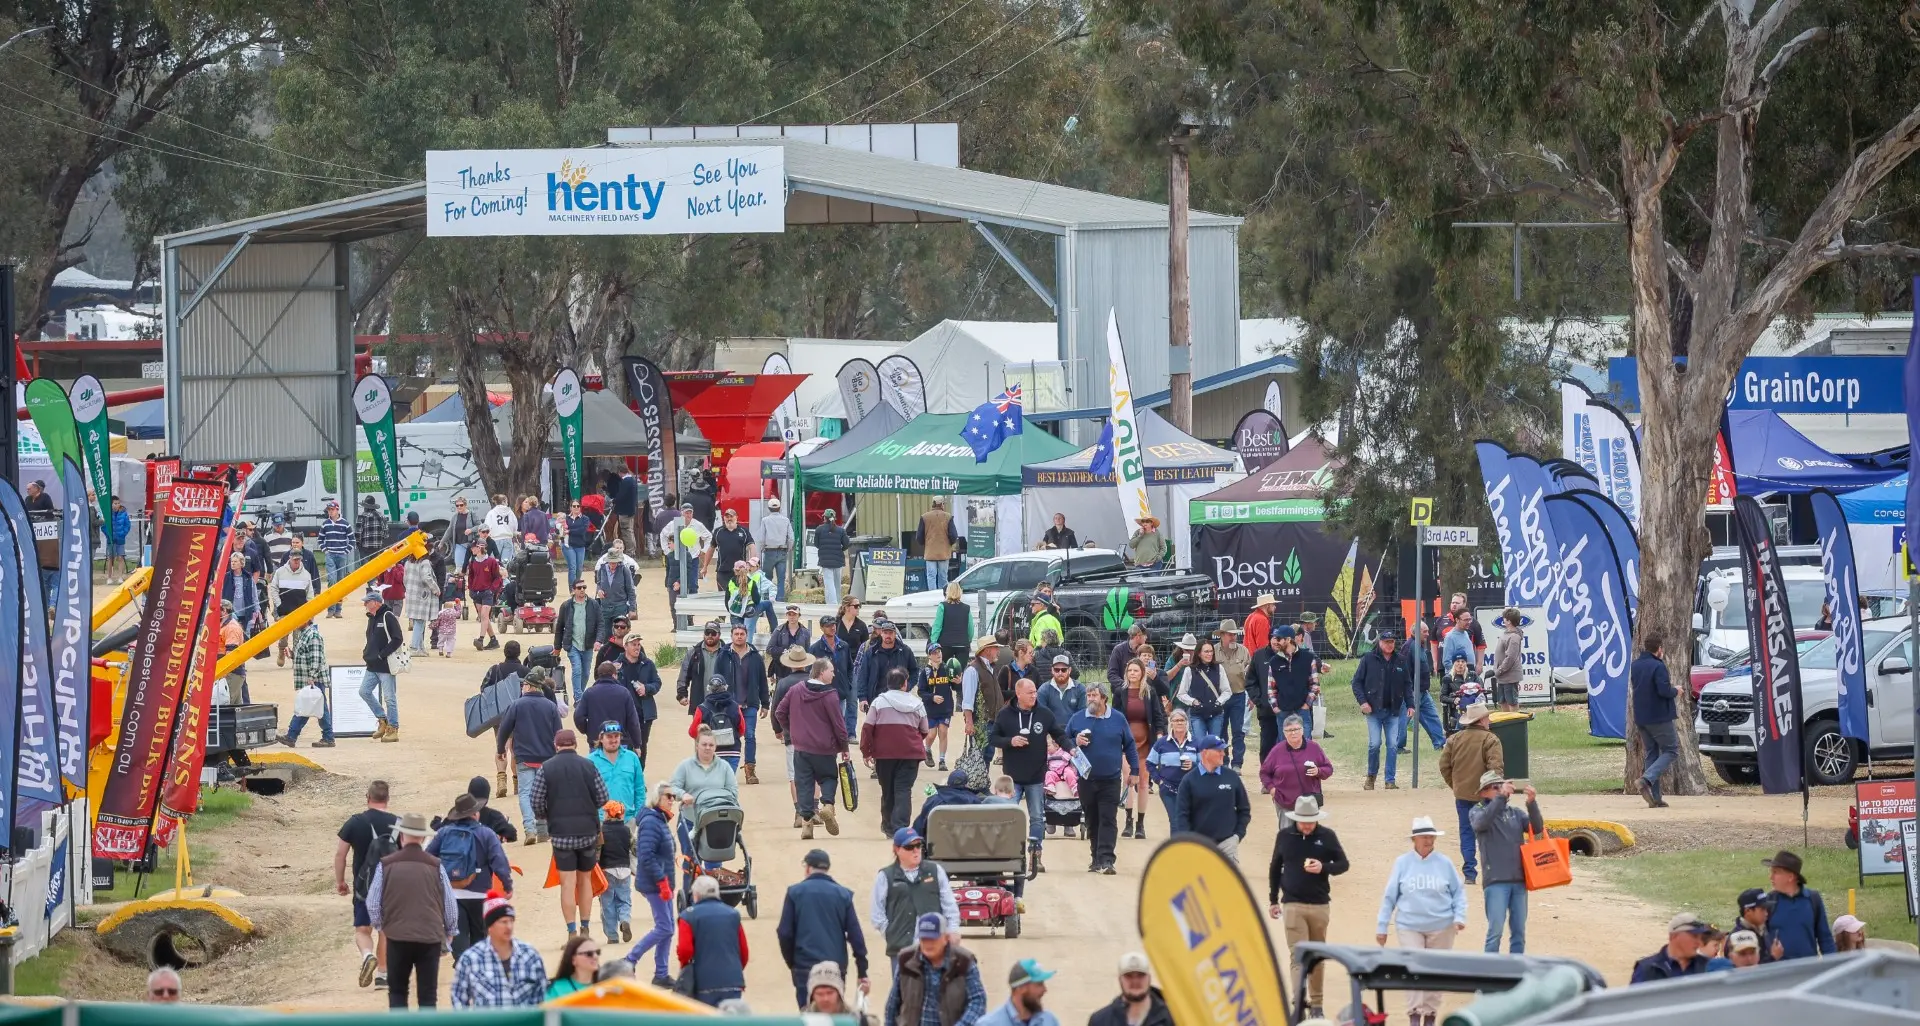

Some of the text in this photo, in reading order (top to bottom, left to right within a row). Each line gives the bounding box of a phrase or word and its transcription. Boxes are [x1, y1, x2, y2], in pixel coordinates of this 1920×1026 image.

[458, 162, 511, 190] Thanks
[692, 158, 759, 186] See You
[445, 187, 528, 222] For Coming!
[546, 172, 666, 221] henty
[687, 189, 767, 220] Next Year.
[549, 214, 640, 222] MACHINERY FIELD DAYS
[1744, 371, 1861, 409] GrainCorp
[1241, 428, 1273, 448] Best
[1147, 442, 1216, 459] BEST
[92, 443, 108, 496] TEKRON
[380, 442, 396, 495] TEKRON
[568, 438, 580, 490] TEKRON
[833, 474, 960, 494] Your Reliable Partner in Hay
[1037, 471, 1057, 483] BEST
[1057, 471, 1093, 483] LEATHER
[1154, 468, 1180, 481] BEST
[174, 486, 221, 500] STEELE
[172, 497, 218, 513] STEEL
[1413, 502, 1431, 521] D
[496, 514, 509, 526] 24
[44, 526, 52, 538] AG
[1427, 530, 1474, 543] 3rd AG PL.
[183, 531, 206, 593] MAXI
[872, 550, 903, 561] BEST
[1212, 555, 1283, 591] Best
[1257, 587, 1301, 597] SYSTEMS
[1466, 581, 1506, 590] SYSTEM
[1151, 594, 1169, 607] Best
[163, 598, 194, 688] FEEDER
[118, 568, 173, 774] sales@steelesteel.com.au
[1523, 683, 1544, 692] 8279
[145, 706, 171, 768] BULK
[1860, 800, 1870, 808] UP
[1882, 799, 1899, 807] 1000
[1860, 806, 1897, 815] INTEREST
